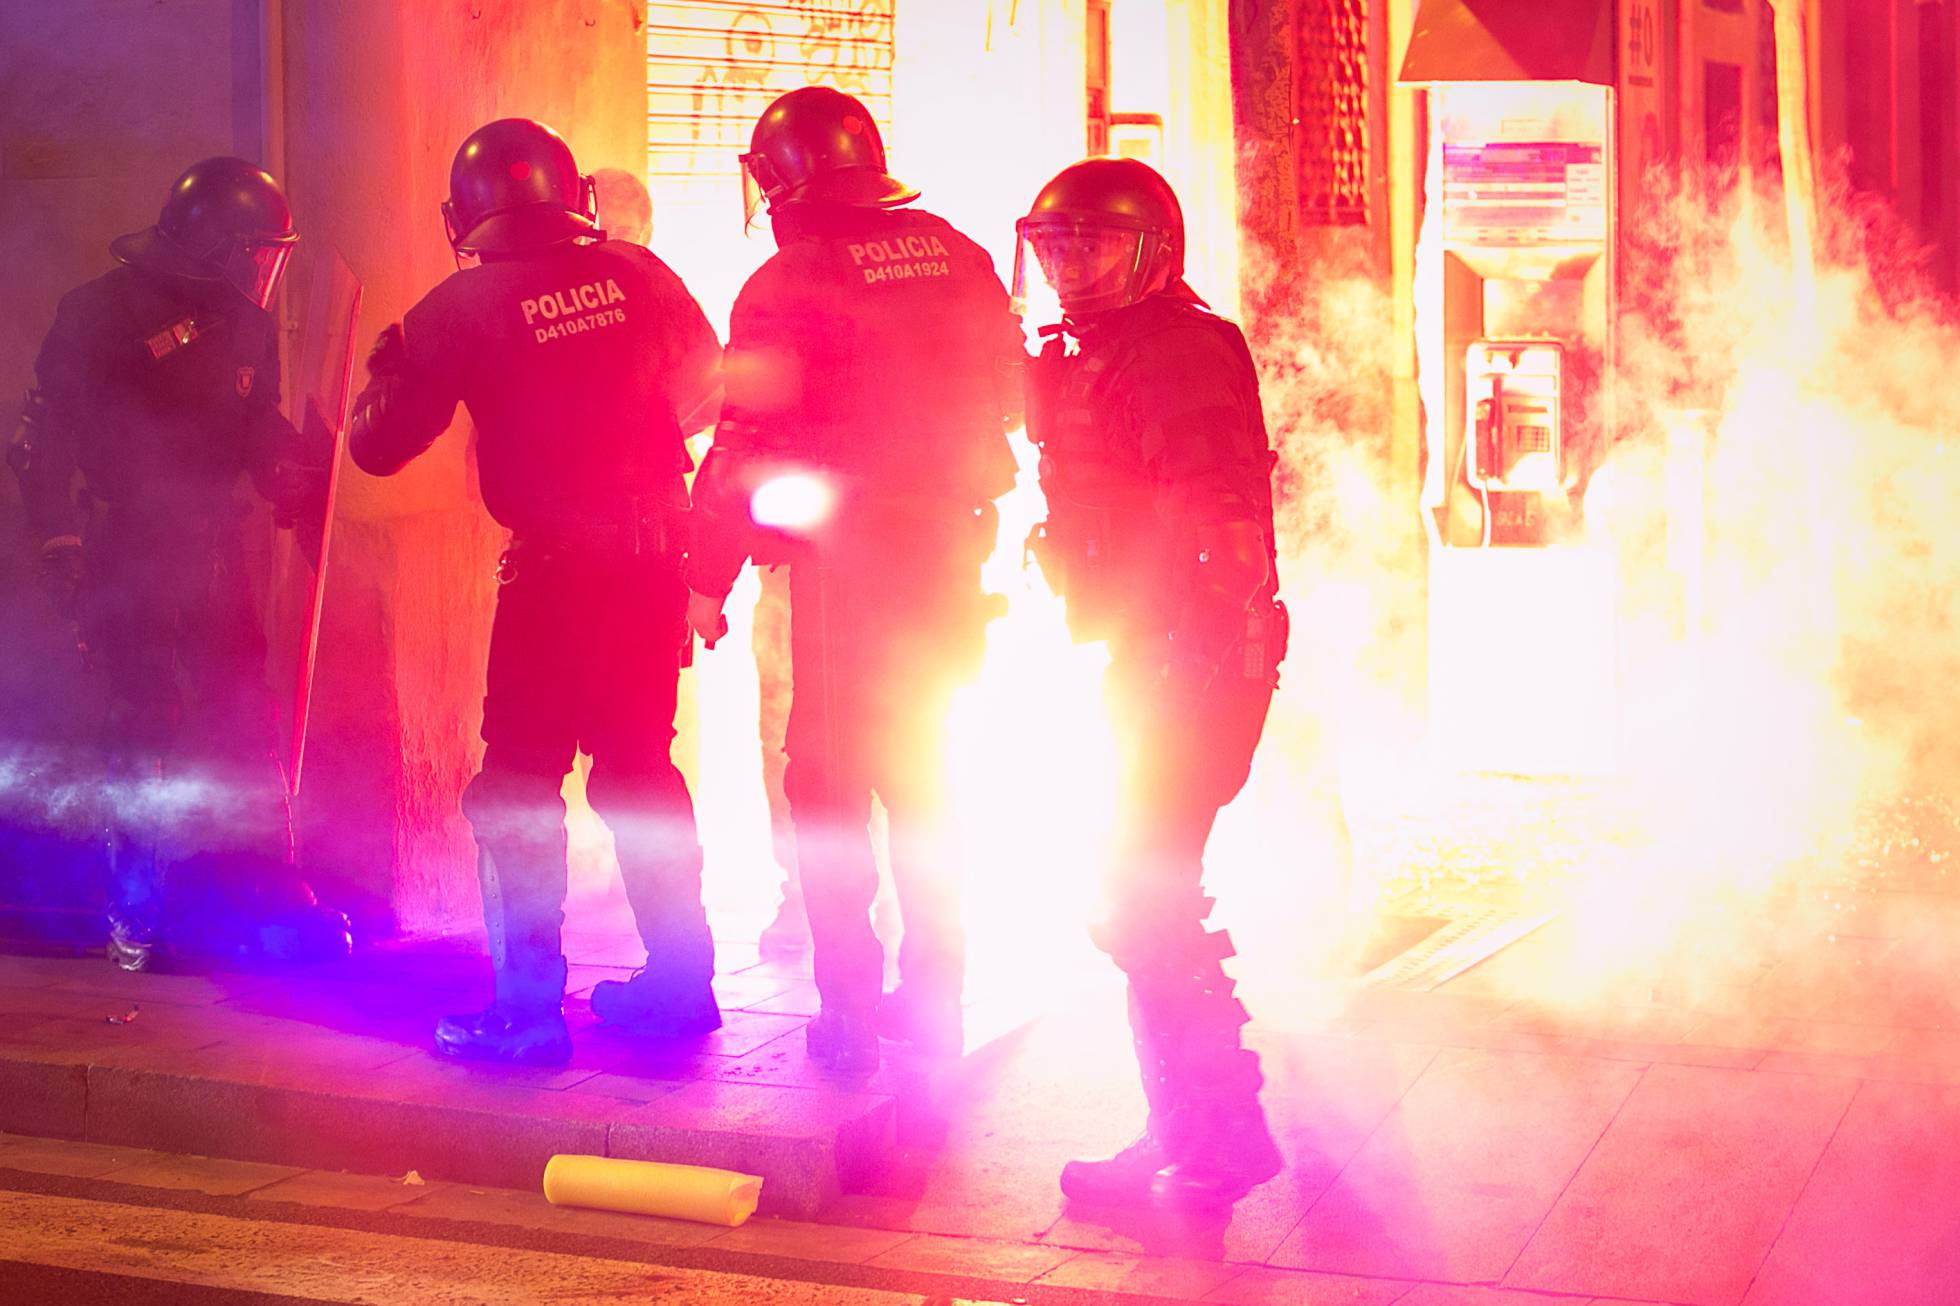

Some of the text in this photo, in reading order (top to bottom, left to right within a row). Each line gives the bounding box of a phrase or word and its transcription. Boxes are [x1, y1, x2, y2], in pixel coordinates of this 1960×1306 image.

[847, 236, 949, 266] POLICIA
[863, 261, 949, 284] D410A1924
[520, 279, 626, 325] POLICIA
[535, 308, 625, 344] D410A7876
